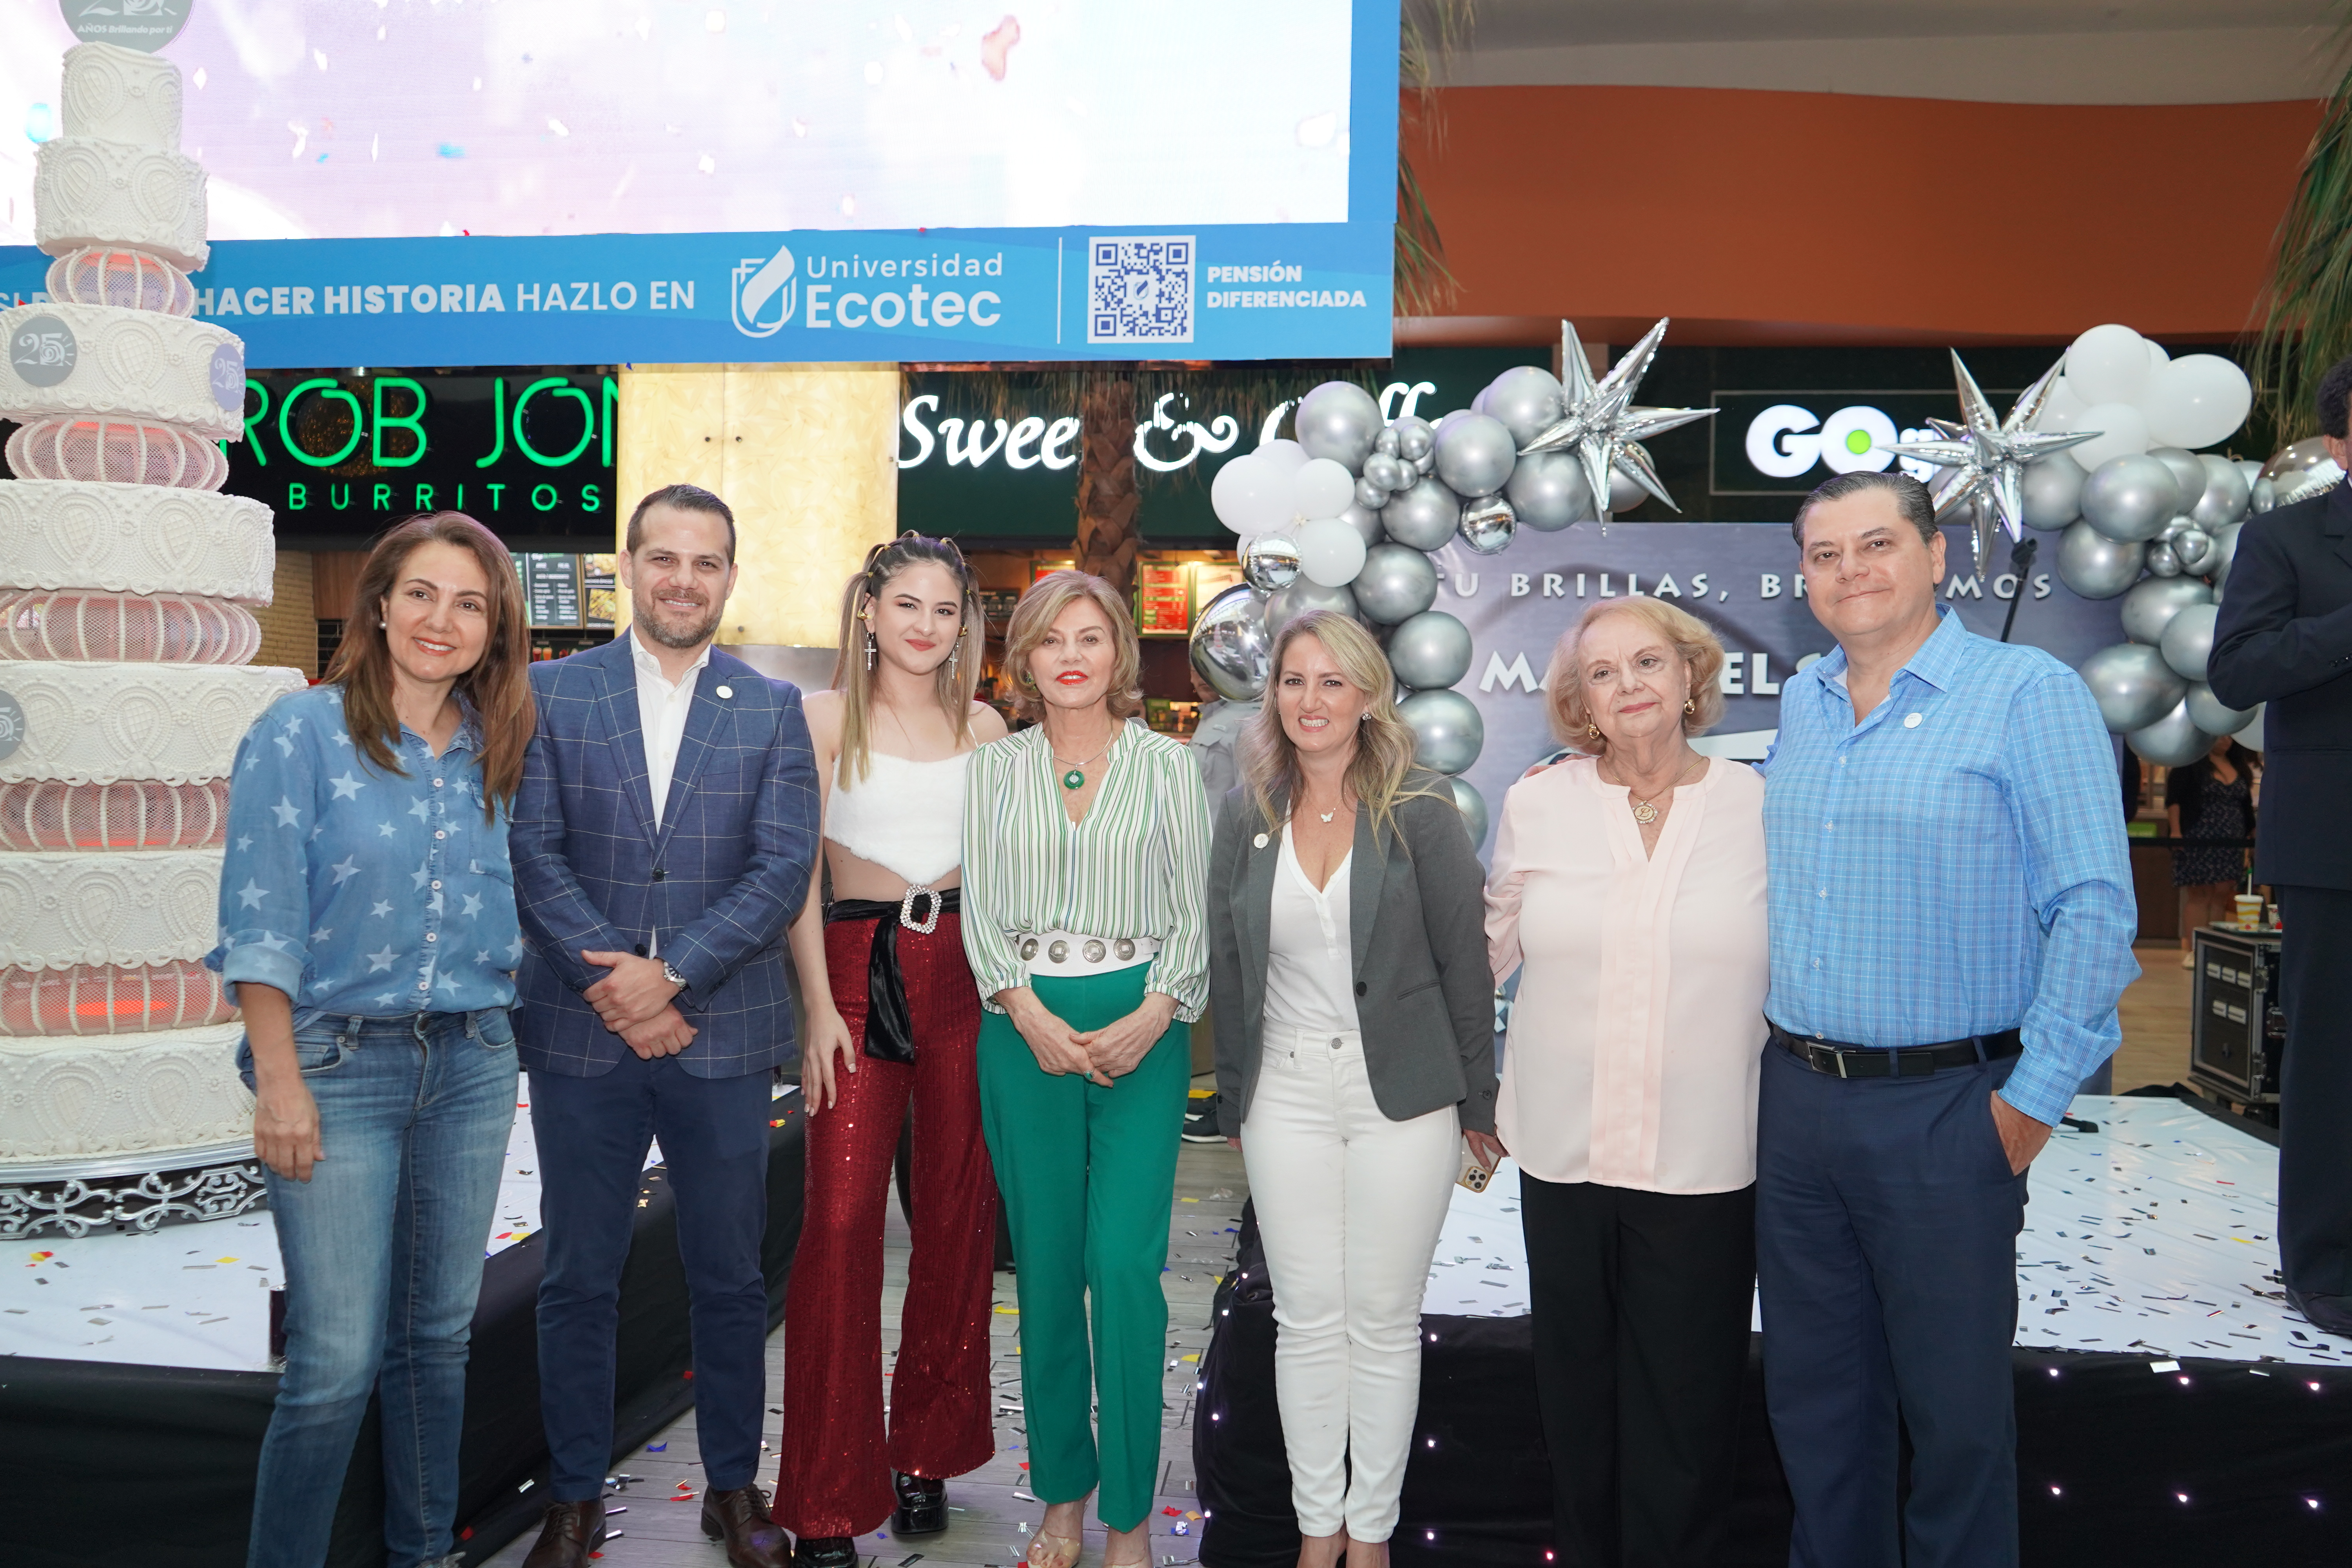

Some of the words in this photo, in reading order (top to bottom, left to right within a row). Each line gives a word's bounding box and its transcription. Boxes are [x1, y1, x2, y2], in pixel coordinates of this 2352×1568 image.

[77, 23, 107, 33] AÑOS
[108, 25, 149, 34] Brillando
[149, 27, 165, 36] por
[806, 252, 1003, 279] Universidad
[1207, 260, 1303, 283] PENSIÓN
[193, 286, 315, 316] HACER
[324, 283, 506, 314] HISTORIA
[517, 281, 638, 312] HAZLO
[650, 280, 695, 310] EN
[806, 283, 1002, 328] Ecotec
[1207, 290, 1367, 309] DIFERENCIADA
[14, 333, 66, 367] 25
[212, 358, 239, 394] 25
[898, 394, 1081, 472] Swee
[288, 482, 601, 512] BURRITOS
[1436, 572, 1479, 597] U
[1511, 572, 1729, 603] BRILLAS,
